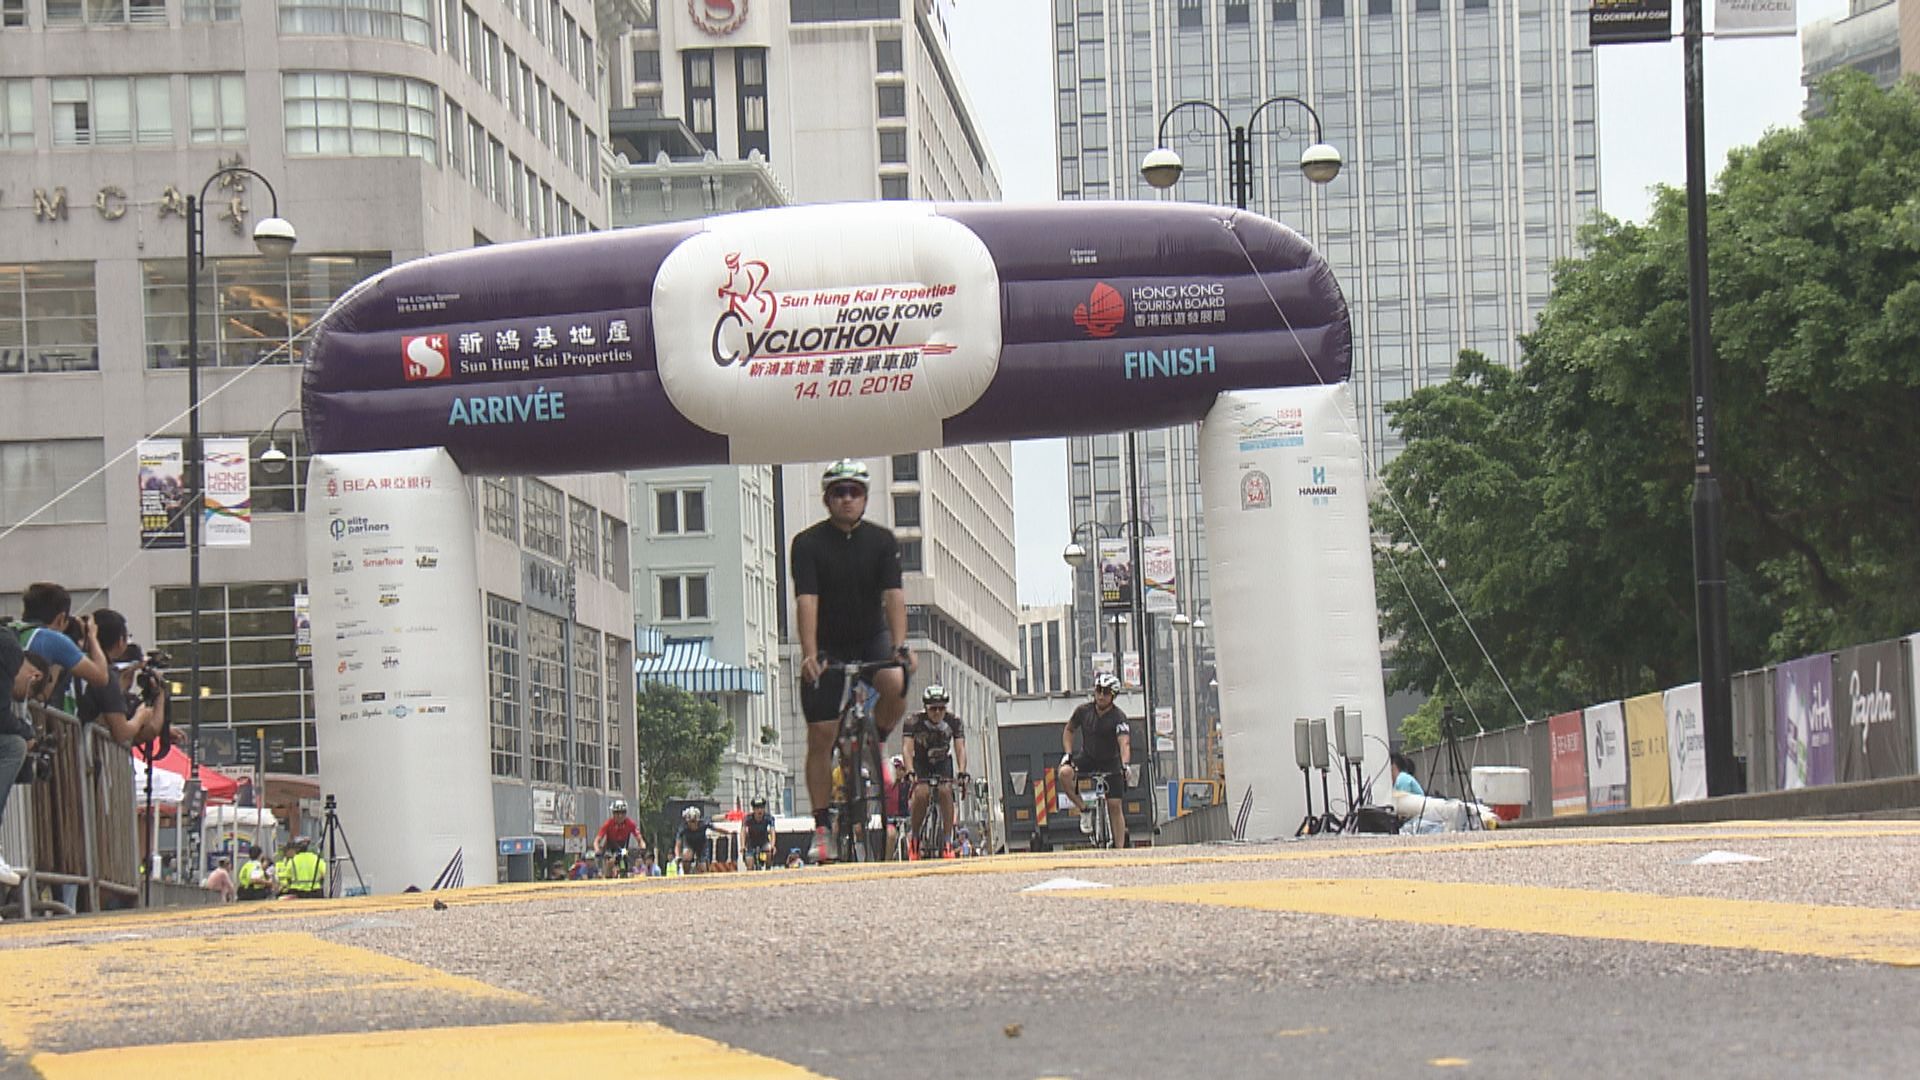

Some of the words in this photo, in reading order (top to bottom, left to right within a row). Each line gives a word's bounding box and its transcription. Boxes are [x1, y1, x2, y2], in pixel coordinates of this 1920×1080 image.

[1751, 2, 1792, 11] EXCEL
[0, 186, 187, 221] MCA
[781, 295, 809, 308] Sun
[814, 292, 850, 307] Hung
[854, 287, 878, 302] Kai
[881, 283, 957, 303] Properties
[1132, 286, 1177, 299] HONG
[1180, 284, 1224, 297] KONG
[1133, 300, 1183, 311] TOURISM
[1184, 297, 1225, 309] BOARD
[836, 306, 889, 323] HONG
[892, 302, 943, 319] KONG
[431, 337, 443, 348] K
[460, 359, 487, 374] Sun
[491, 356, 530, 372] Hung
[534, 352, 558, 367] Kai
[562, 349, 633, 366] Properties
[828, 352, 920, 376] 香港單車節
[1124, 346, 1216, 380] FINISH
[409, 364, 421, 377] H
[794, 381, 820, 399] 14.
[827, 379, 853, 397] 10.
[859, 374, 914, 395] 2018
[448, 385, 566, 425] ARRIVÉE
[208, 472, 246, 481] HONG
[208, 482, 246, 492] KONG
[343, 479, 377, 492] BEA
[1299, 486, 1337, 495] HAMMER
[348, 523, 390, 535] partners
